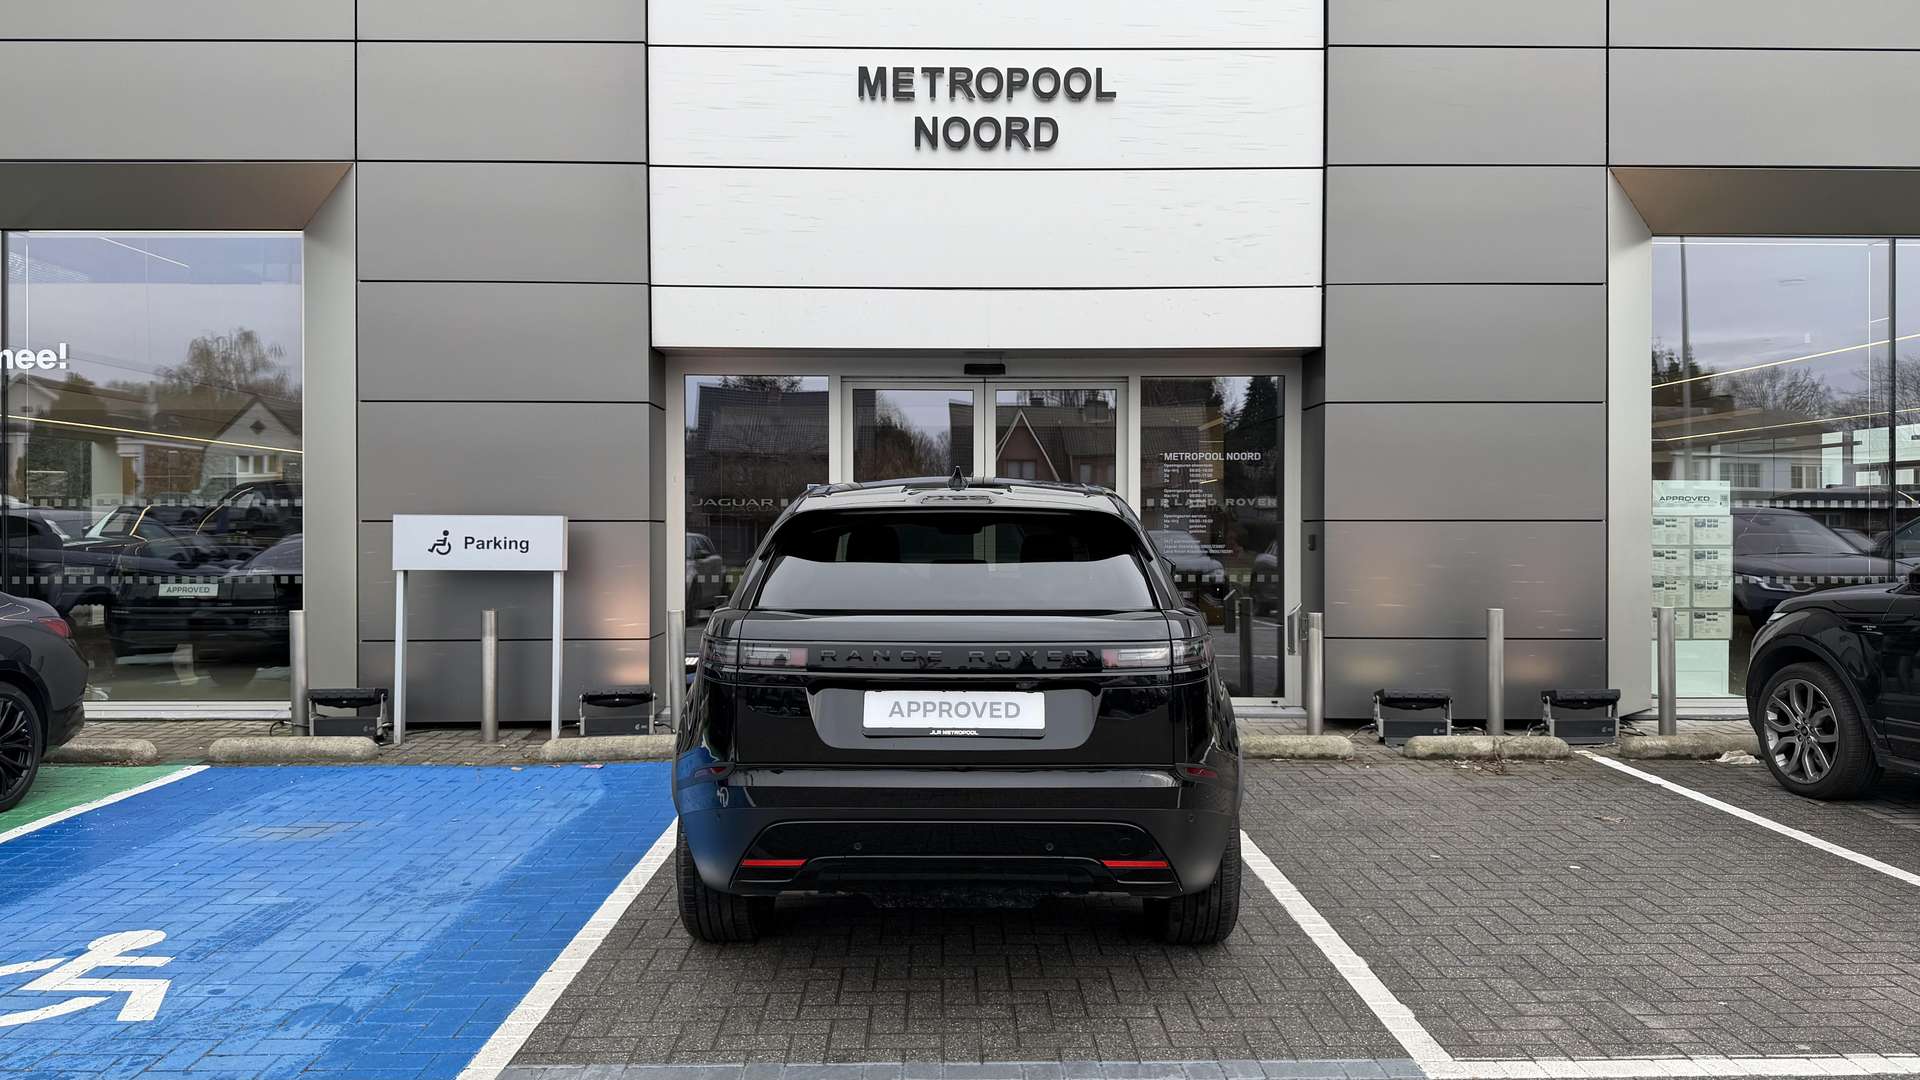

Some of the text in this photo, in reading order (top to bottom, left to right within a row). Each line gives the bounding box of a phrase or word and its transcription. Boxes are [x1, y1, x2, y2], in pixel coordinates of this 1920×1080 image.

[858, 66, 1117, 101] METROPOOL
[914, 116, 1059, 151] NOORD
[1164, 452, 1261, 461] METROPOOL NOORD
[691, 499, 774, 507] JAGUAR
[1225, 498, 1278, 507] ROVER
[1659, 495, 1710, 503] APPROVED
[463, 536, 530, 554] Parking
[166, 585, 210, 595] APPROVED
[820, 649, 1090, 663] RANGE ROVER
[889, 700, 1021, 719] APPROVED
